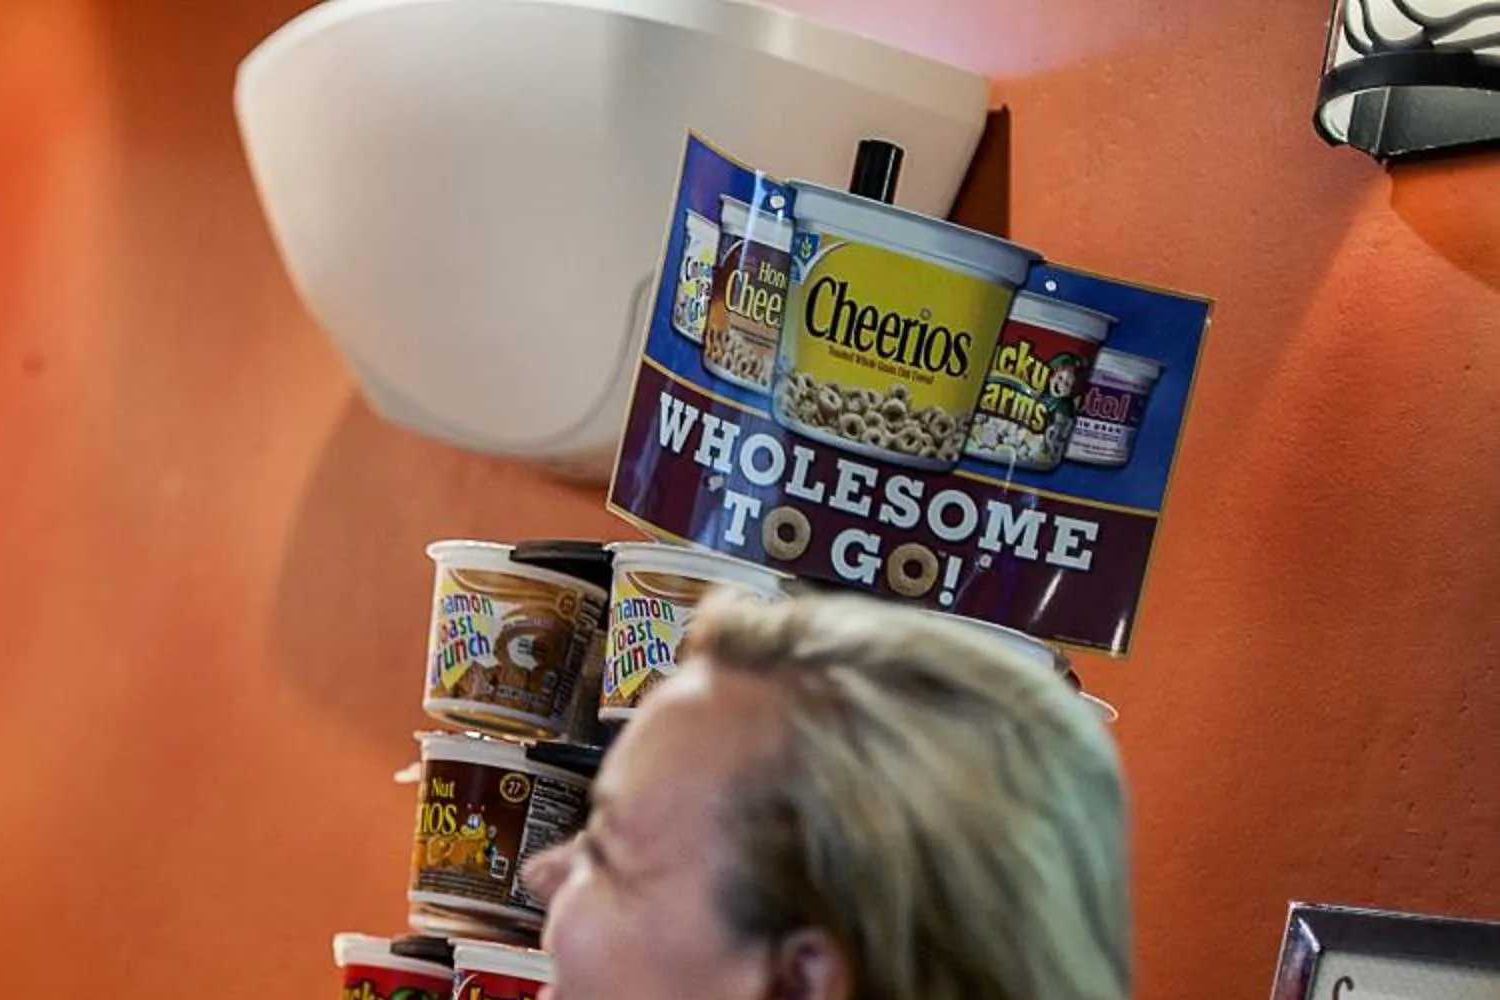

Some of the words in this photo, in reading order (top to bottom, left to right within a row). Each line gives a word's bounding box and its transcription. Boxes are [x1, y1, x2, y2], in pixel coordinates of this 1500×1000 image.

[725, 269, 783, 326] Chee
[805, 276, 973, 378] Cheerios
[998, 341, 1051, 394] cky
[979, 383, 1047, 433] arms
[1082, 387, 1132, 423] tal
[659, 392, 1099, 570] WHOLESOME
[723, 489, 812, 560] TO
[831, 528, 963, 606] GO!
[438, 614, 476, 644] oast
[432, 778, 456, 799] Nut
